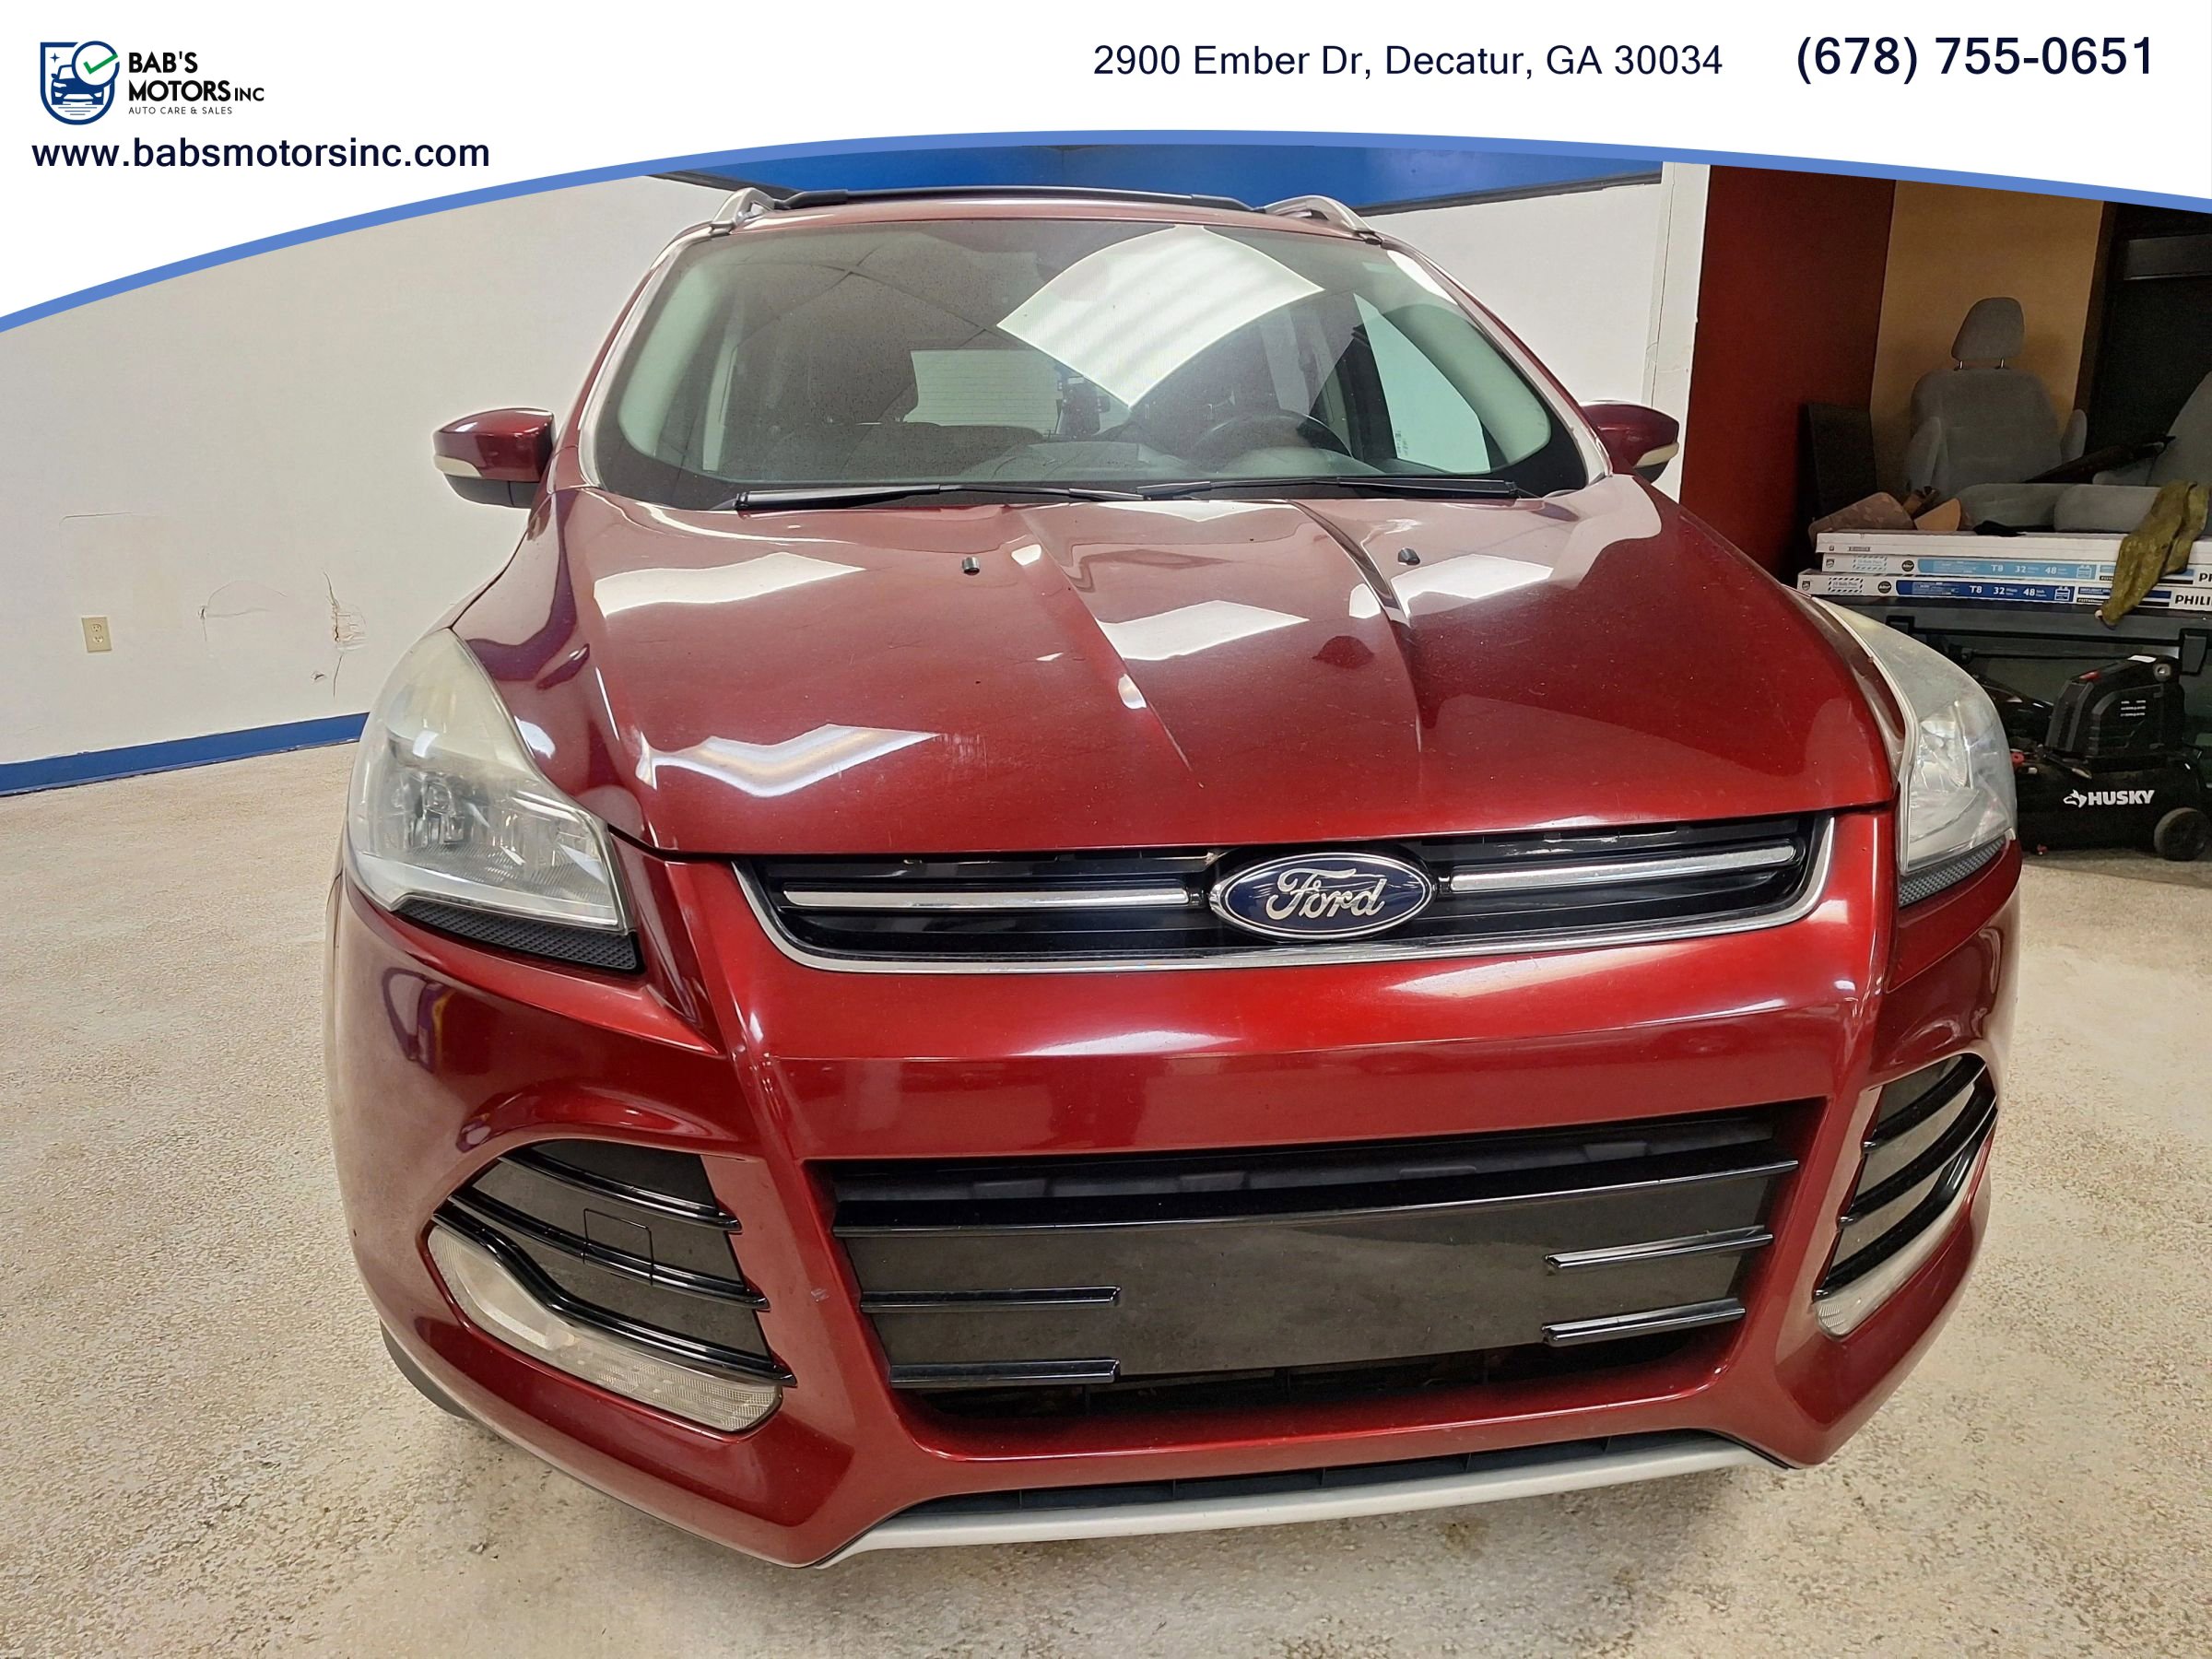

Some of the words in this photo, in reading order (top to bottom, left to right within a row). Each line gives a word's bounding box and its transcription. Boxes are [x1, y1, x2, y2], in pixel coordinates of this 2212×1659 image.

[1991, 564, 2004, 572] T8
[2015, 565, 2027, 573] 32
[1969, 585, 1983, 594] T8
[1994, 586, 2006, 594] 32
[2023, 588, 2035, 596] 48
[2175, 594, 2212, 606] PHILI
[2088, 790, 2155, 806] HUSKY
[1266, 867, 1387, 920] Ford
